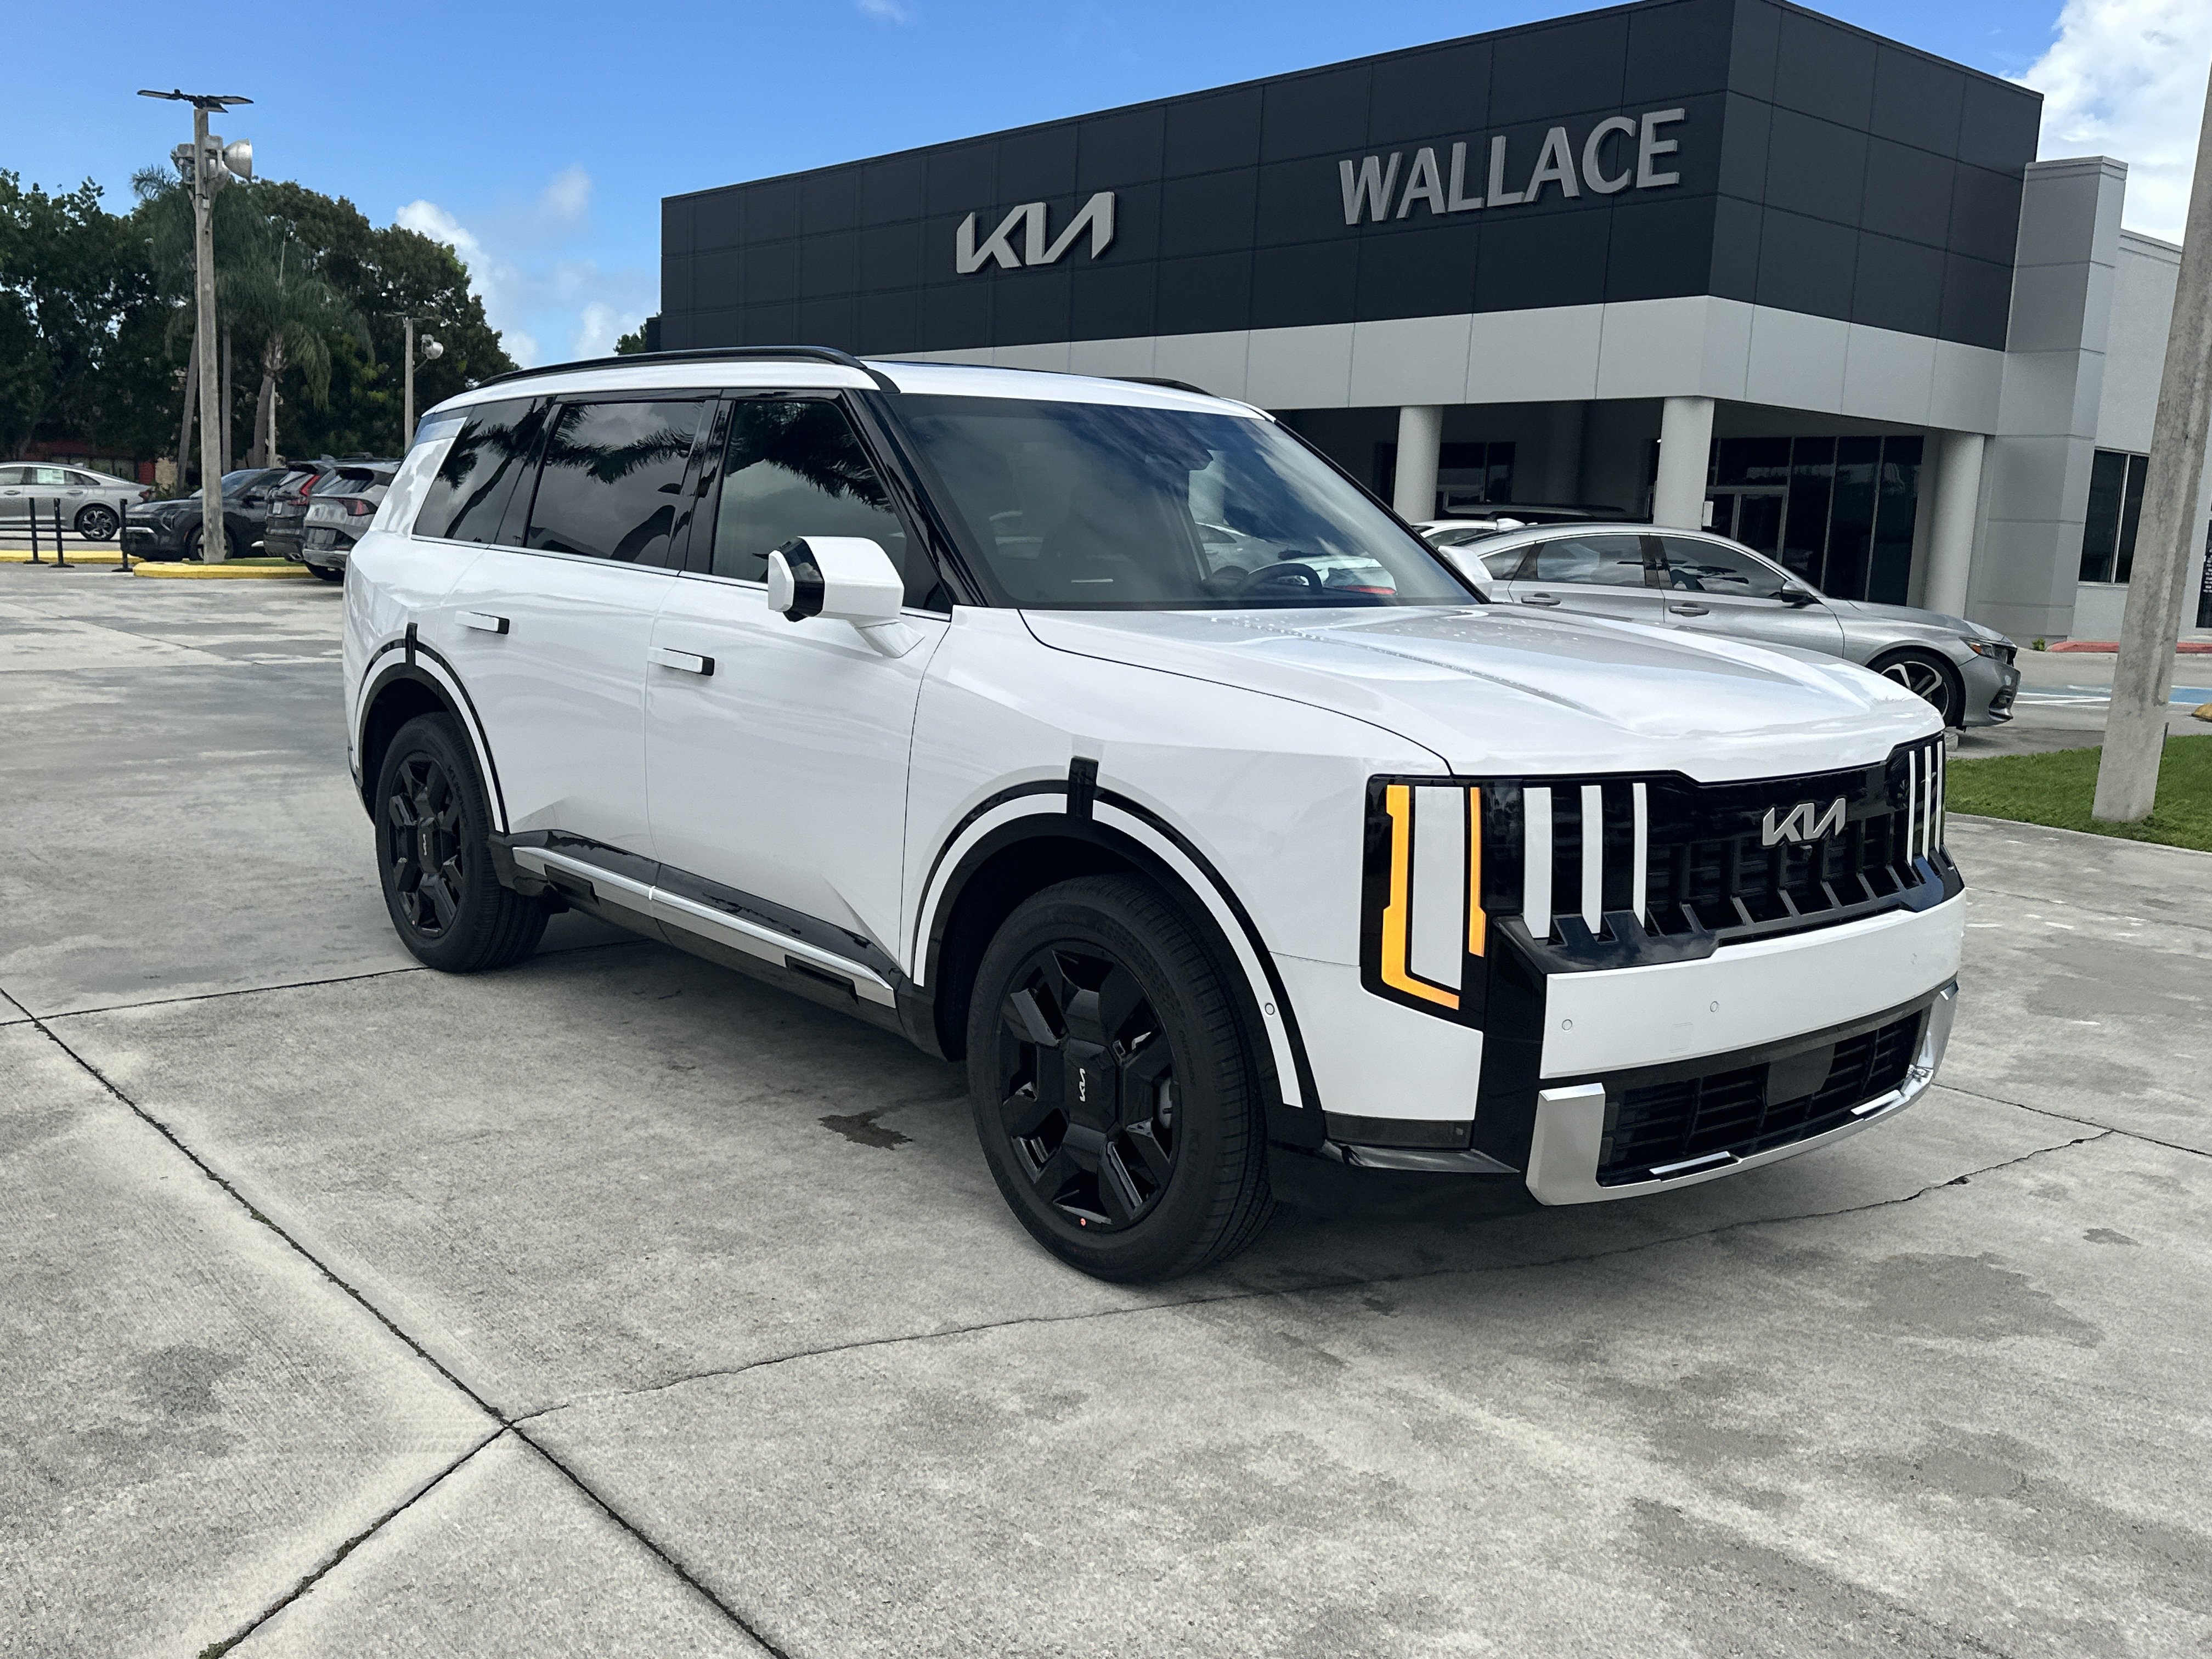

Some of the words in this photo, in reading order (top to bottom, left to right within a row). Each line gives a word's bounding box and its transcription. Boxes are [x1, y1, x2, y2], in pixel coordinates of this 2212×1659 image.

[1339, 108, 1685, 225] WALLACE
[956, 191, 1115, 274] KIA
[1762, 798, 1846, 846] KIA
